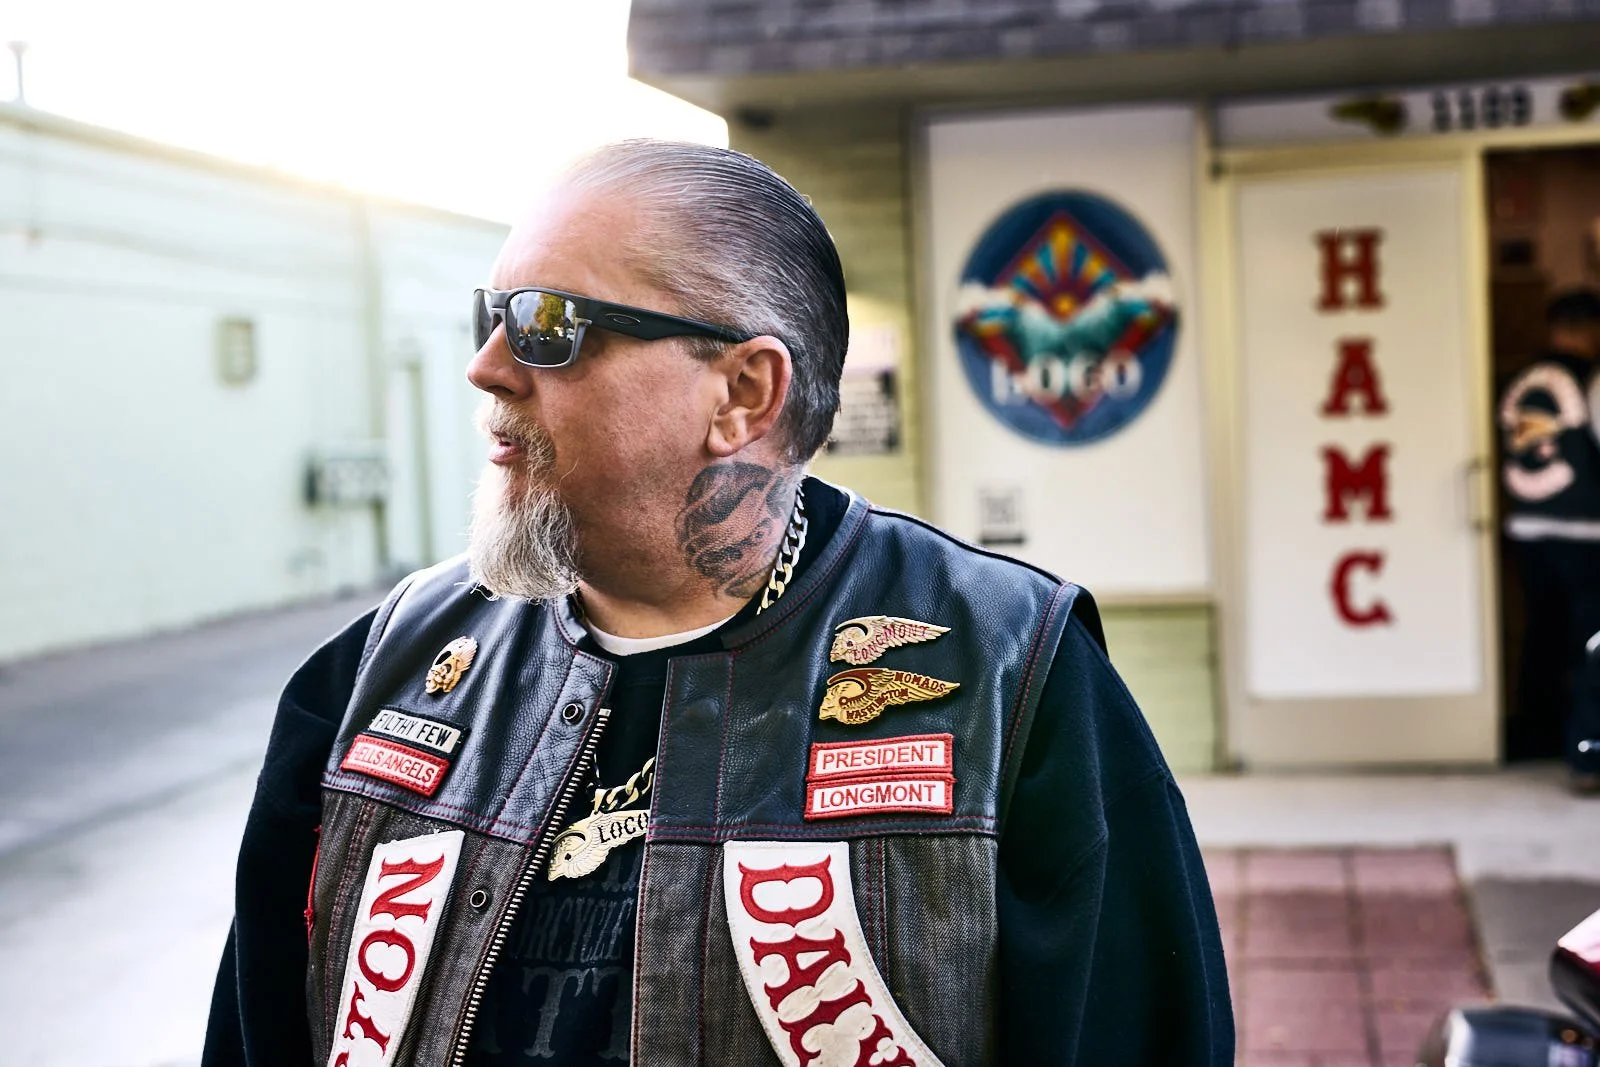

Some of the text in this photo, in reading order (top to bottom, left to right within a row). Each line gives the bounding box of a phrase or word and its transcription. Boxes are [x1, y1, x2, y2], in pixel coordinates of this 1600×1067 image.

[852, 624, 929, 662] LONGMONT
[895, 672, 946, 693] NOMADS
[846, 688, 909, 719] WASHINGTON
[374, 713, 452, 747] FILTHY FEW
[380, 753, 435, 783] ANGELS
[822, 745, 938, 770] PRESIDENT
[820, 784, 937, 809] LONGMONT
[598, 812, 649, 843] LOCO
